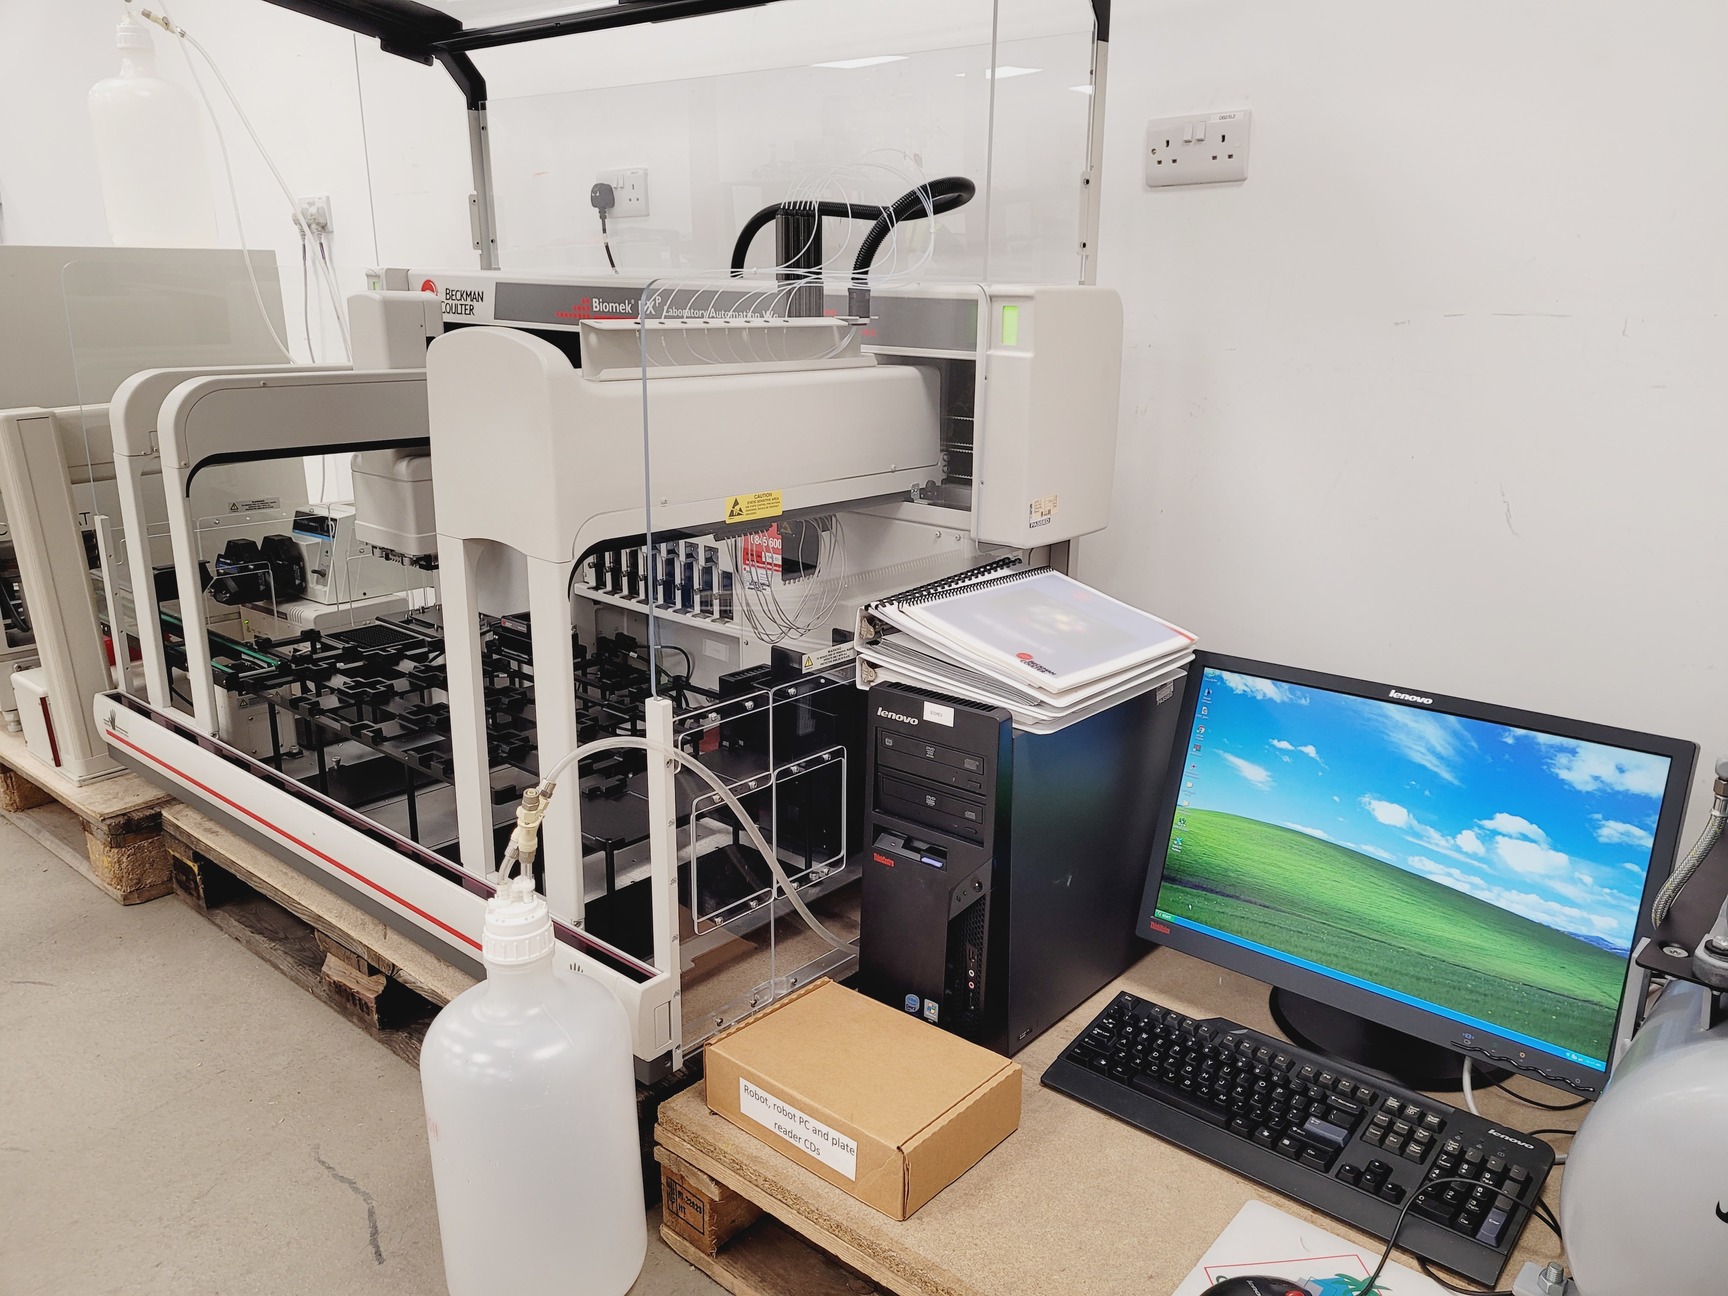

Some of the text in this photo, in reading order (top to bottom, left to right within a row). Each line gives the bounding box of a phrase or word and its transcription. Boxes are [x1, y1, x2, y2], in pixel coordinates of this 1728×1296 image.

[445, 288, 484, 302] BECKMAN
[441, 301, 475, 316] COULTER
[664, 306, 708, 318] Laboratory
[1389, 689, 1433, 704] lenovo
[877, 706, 919, 725] lenovo
[744, 1085, 855, 1156] Robot, robot PC and plate
[774, 1122, 821, 1156] reader CDs
[1488, 1129, 1534, 1149] lenovo
